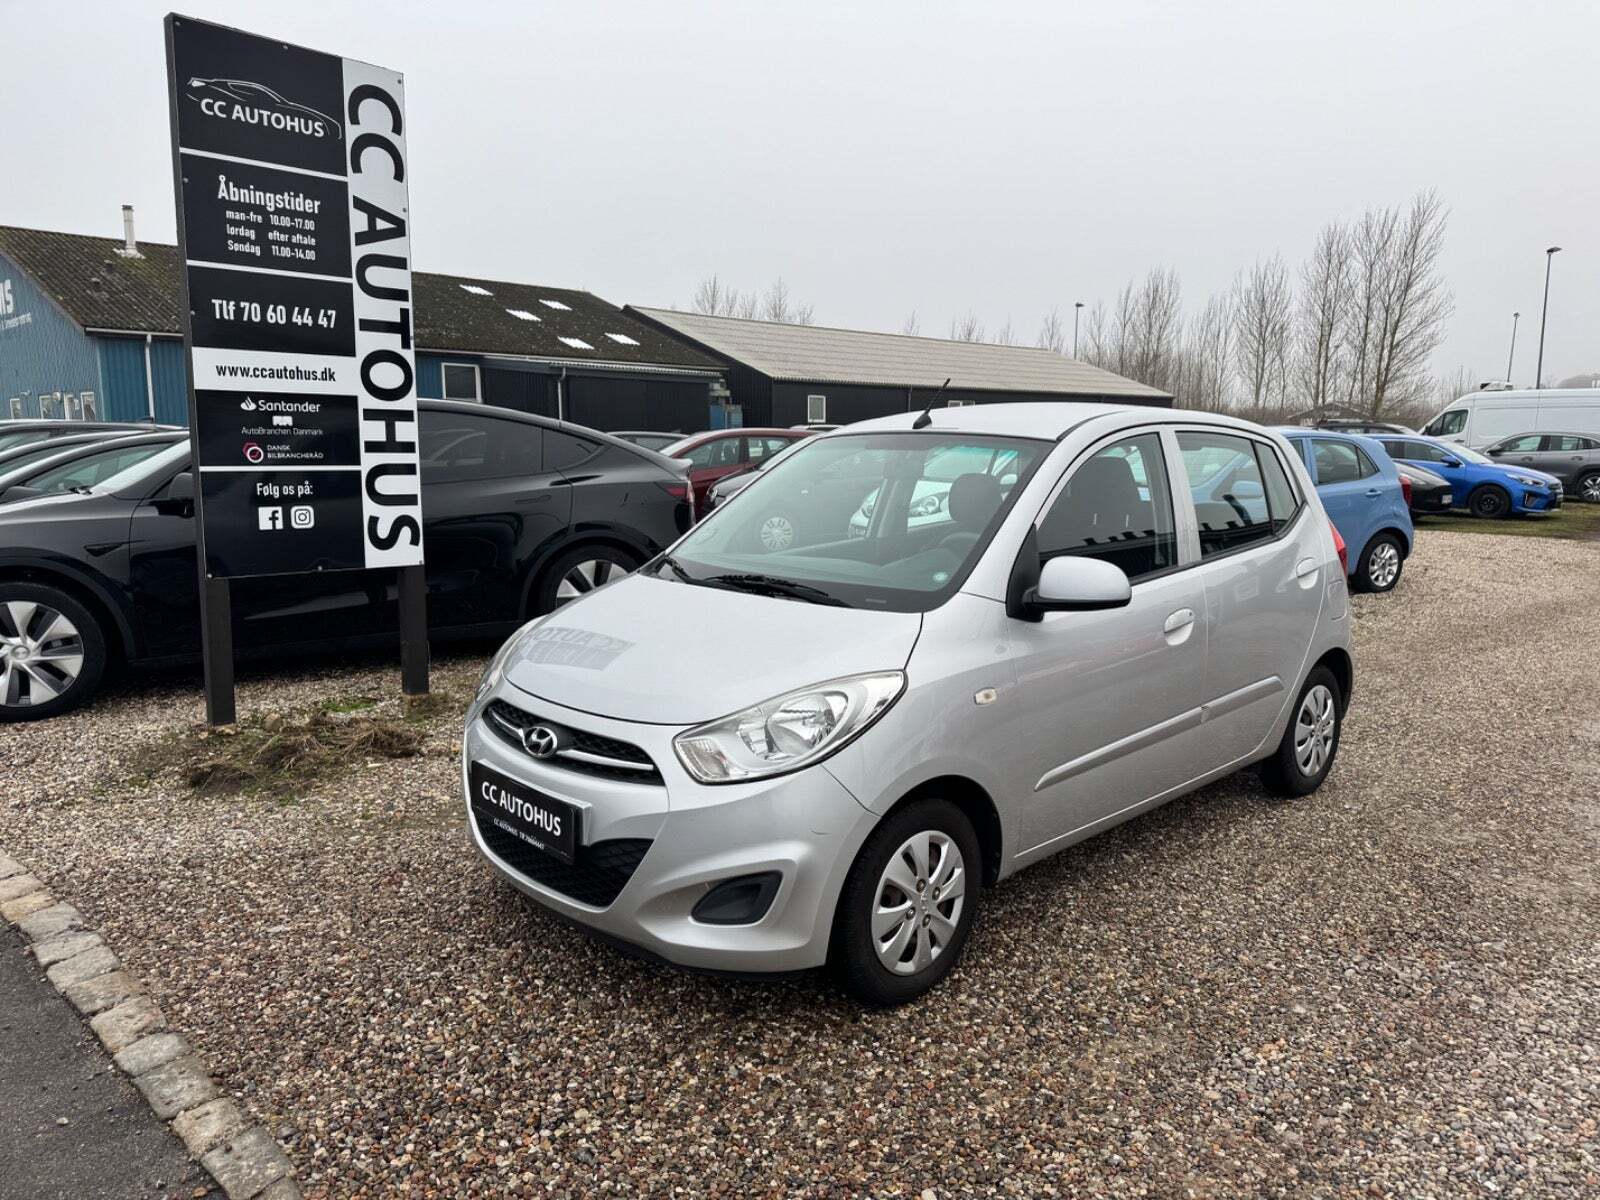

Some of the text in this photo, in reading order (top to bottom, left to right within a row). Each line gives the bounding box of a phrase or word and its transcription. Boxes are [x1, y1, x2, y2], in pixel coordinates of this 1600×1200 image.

[201, 98, 324, 137] CC AUTOHUS
[217, 174, 321, 214] Åbningstider
[225, 210, 315, 231] man-fre 10.00-17.00
[268, 230, 289, 242] efter
[291, 233, 316, 246] aftale
[271, 245, 316, 260] 11.00-14.00
[211, 298, 336, 329] Tlf 70 60 44 47
[348, 84, 421, 551] CC AUTOHUS
[215, 365, 337, 382] www.ccautohus.dk
[258, 400, 321, 412] Santander
[282, 485, 295, 495] os
[297, 480, 313, 498] på:
[482, 781, 562, 836] CC AUTOHUS
